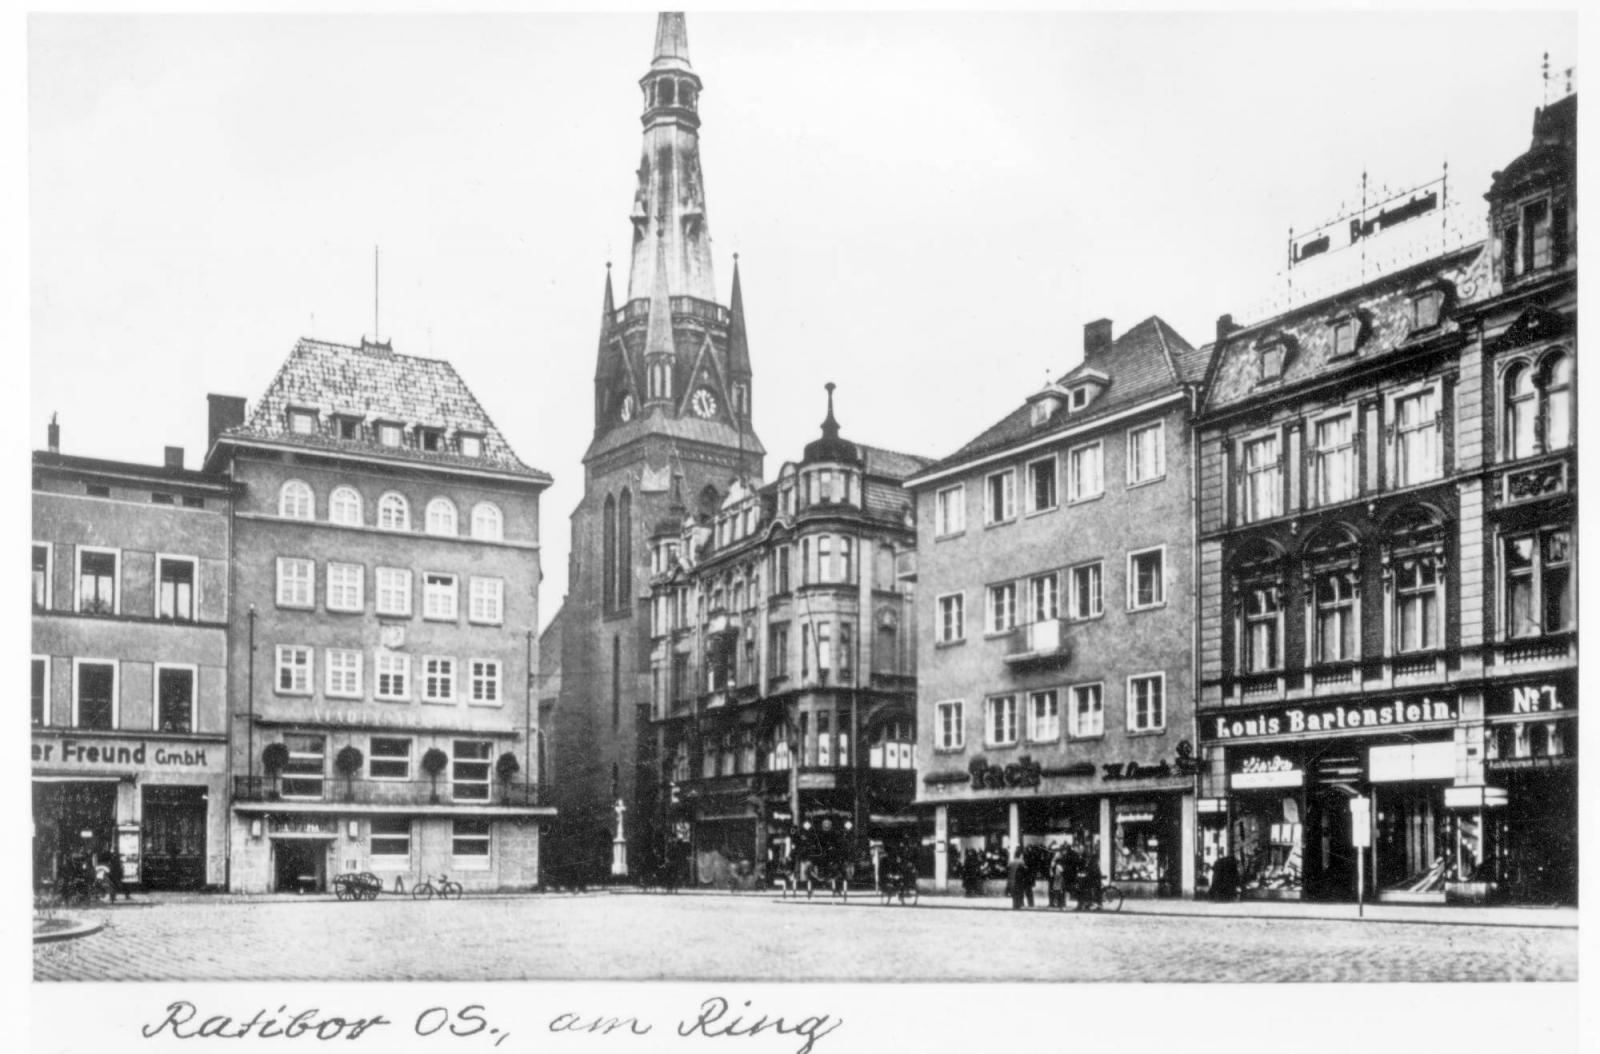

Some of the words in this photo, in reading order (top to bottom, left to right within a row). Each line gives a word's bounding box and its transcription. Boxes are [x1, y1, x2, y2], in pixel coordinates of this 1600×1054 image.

[1216, 715, 1281, 739] Louis
[62, 739, 145, 765] Freund
[154, 748, 207, 766] GmbH
